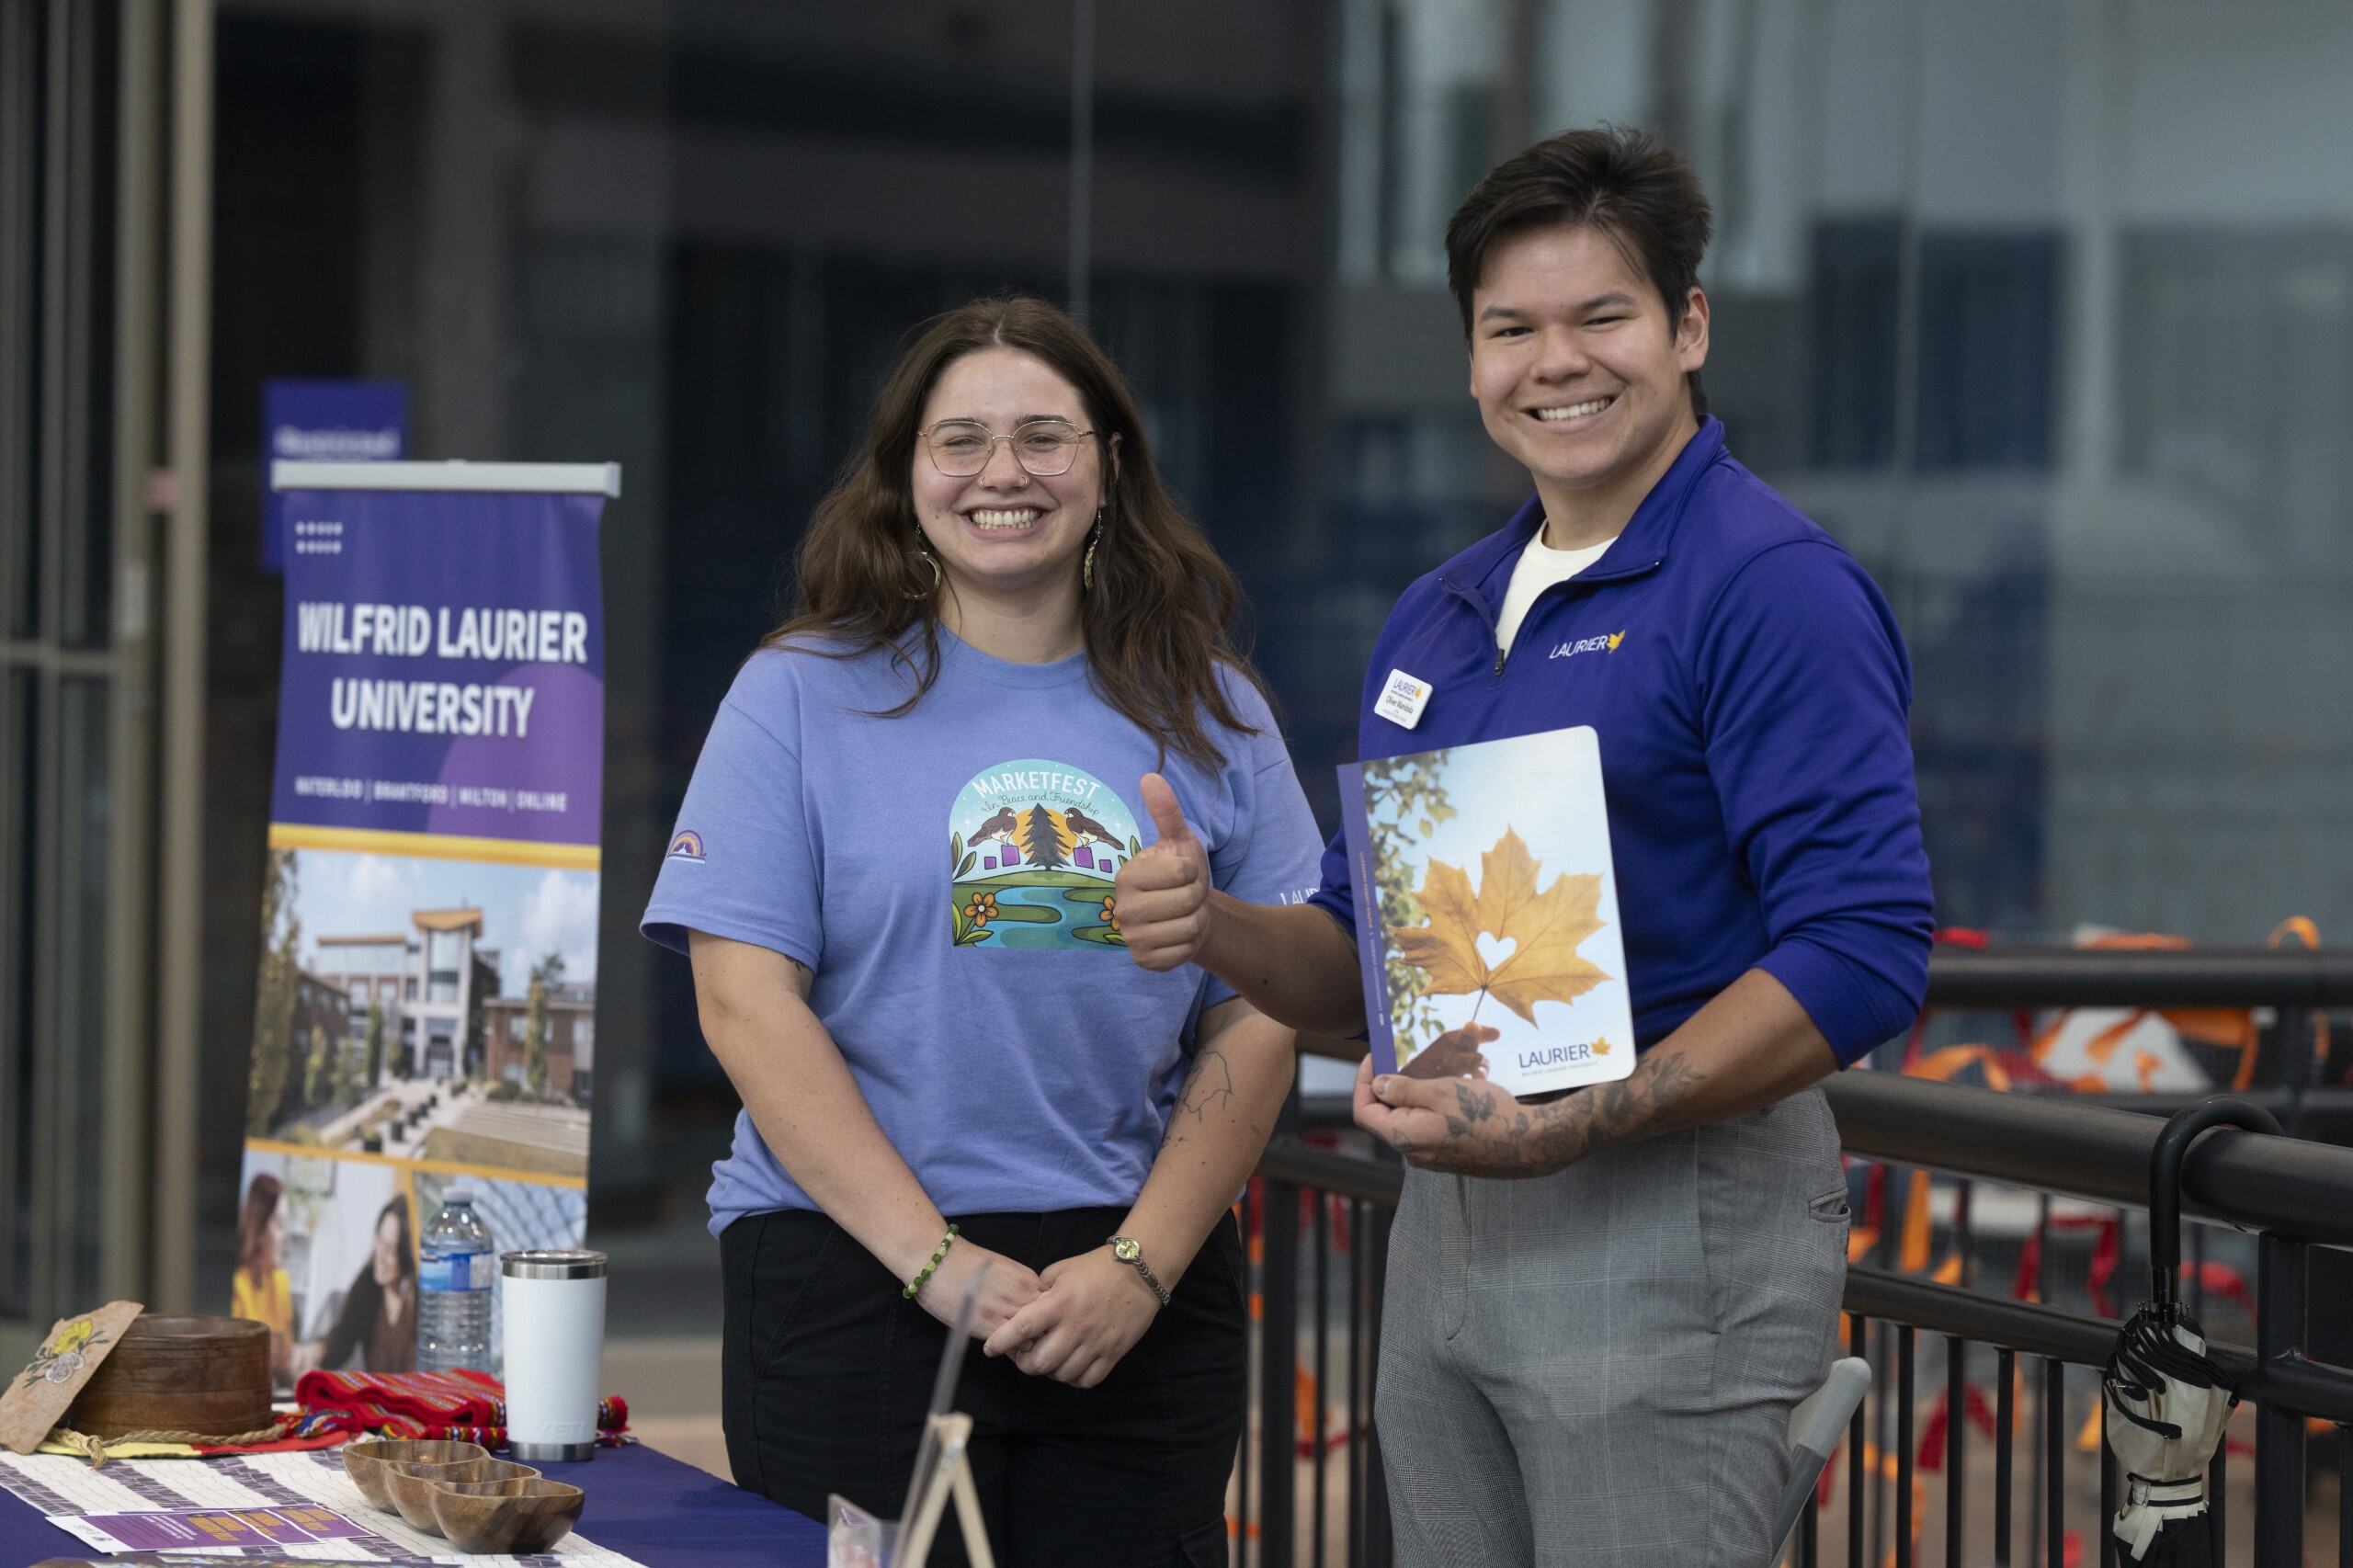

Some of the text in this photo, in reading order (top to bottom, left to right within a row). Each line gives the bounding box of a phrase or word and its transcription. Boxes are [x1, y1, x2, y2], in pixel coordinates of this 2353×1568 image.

[297, 601, 588, 664] WILFRID LAURIER
[1549, 634, 1609, 660] LAURIER
[330, 677, 536, 738] UNIVERSITY
[294, 776, 568, 813] WATERLOO BRANTFORD MILTON ONLINE
[972, 771, 1101, 799] MARKETFEST
[998, 794, 1027, 806] Peace
[1028, 791, 1049, 801] and
[1049, 791, 1100, 816] Friendship
[1518, 1043, 1591, 1069] LAURIER
